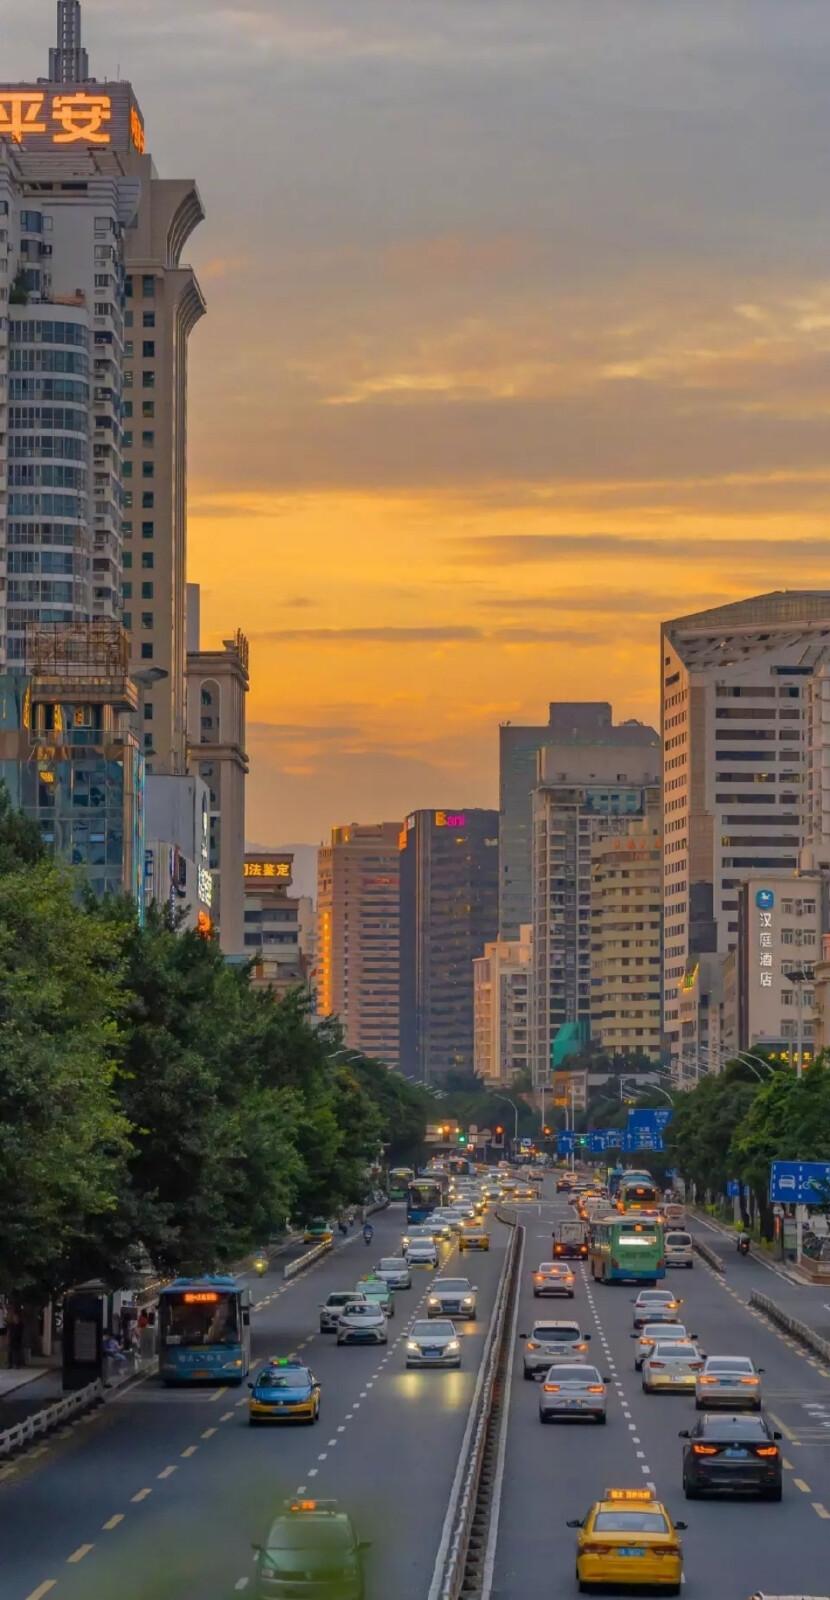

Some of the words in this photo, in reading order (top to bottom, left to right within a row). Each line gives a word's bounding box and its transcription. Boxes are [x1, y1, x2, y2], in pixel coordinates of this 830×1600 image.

[0, 92, 111, 144] 平安
[759, 912, 773, 987] 汉庭酒店
